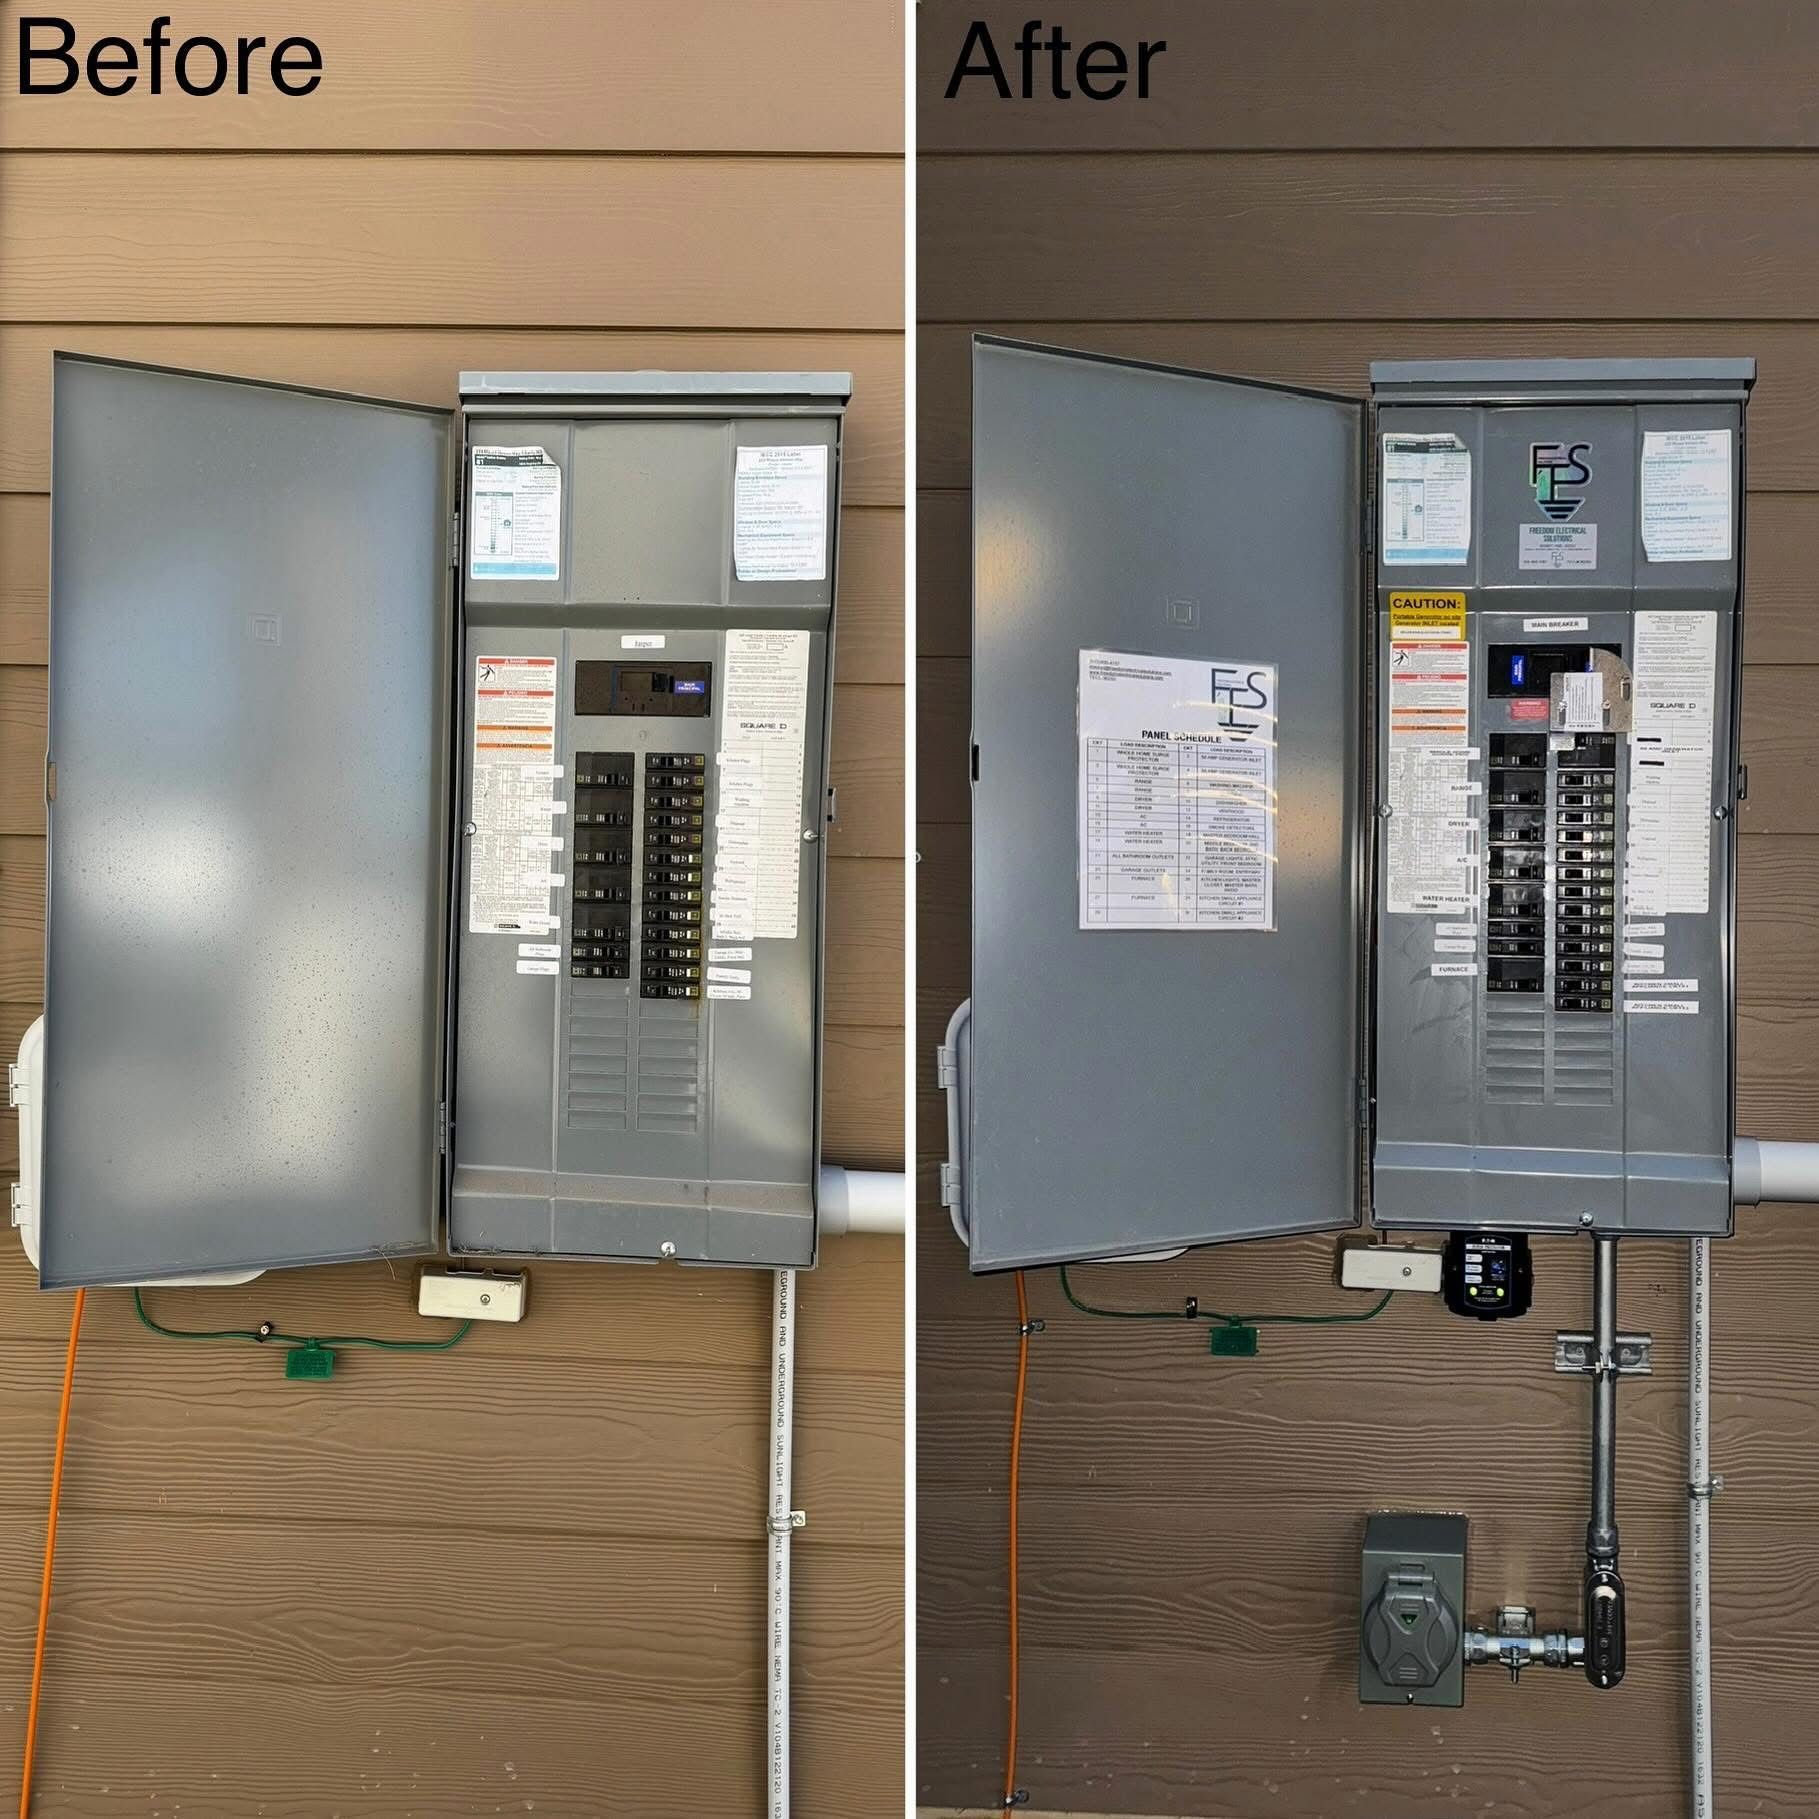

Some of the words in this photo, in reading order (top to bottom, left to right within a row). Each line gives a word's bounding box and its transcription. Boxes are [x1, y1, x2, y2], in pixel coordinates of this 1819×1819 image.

[1392, 598, 1460, 608] CAUTION:
[1142, 730, 1171, 740] PANEL
[1174, 732, 1222, 743] SCHEDULE
[777, 1353, 785, 1428] UNDERGROUND
